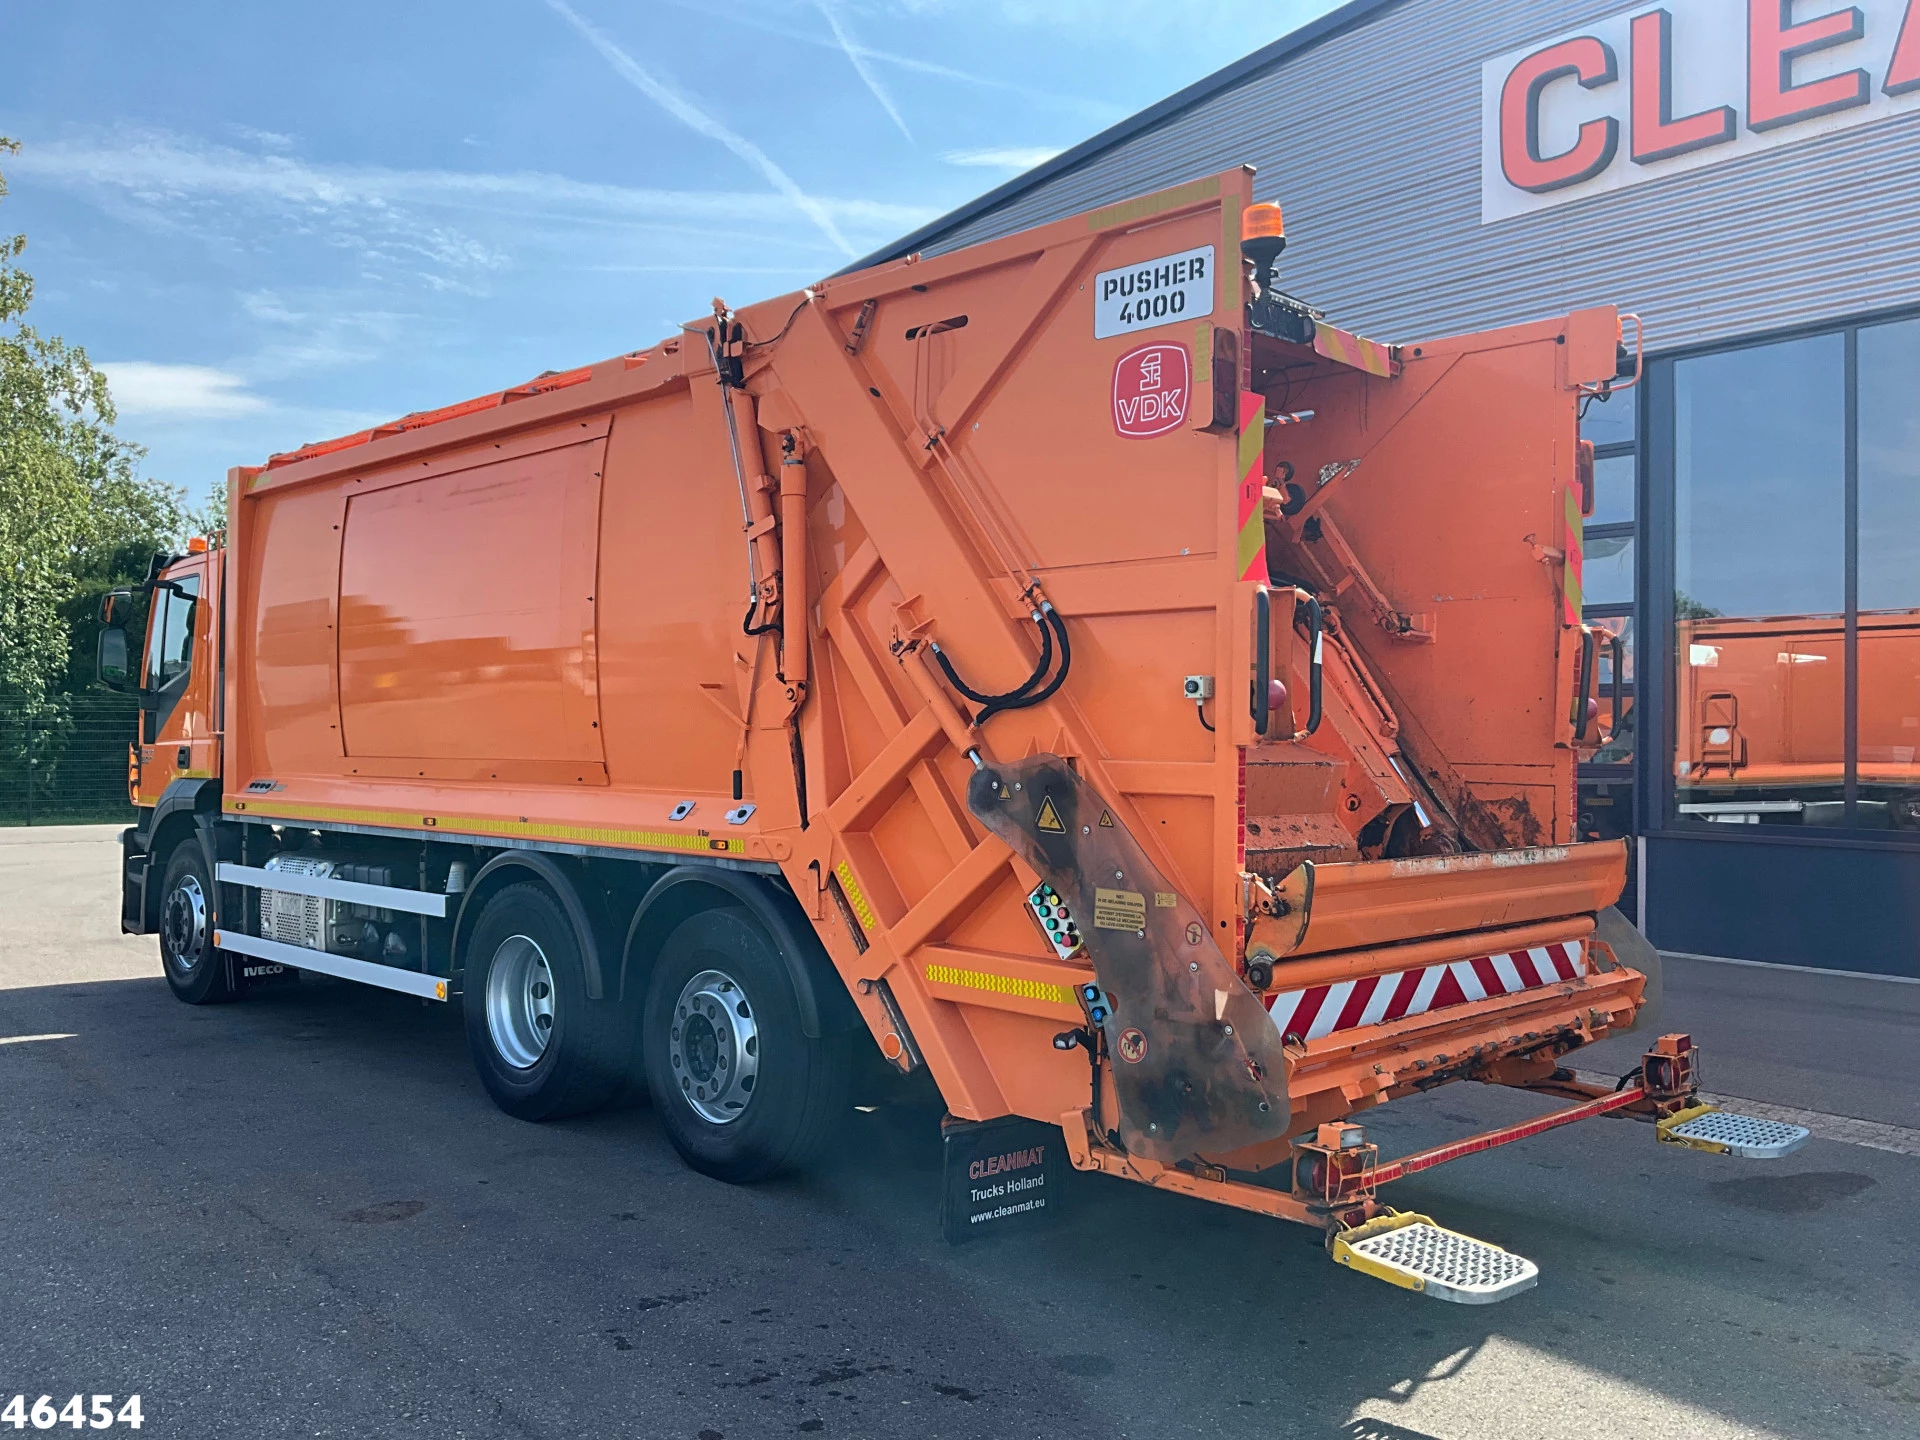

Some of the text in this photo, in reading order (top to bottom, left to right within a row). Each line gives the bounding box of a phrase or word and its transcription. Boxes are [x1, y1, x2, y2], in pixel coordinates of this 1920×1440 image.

[1103, 257, 1205, 301] PUSHER
[1119, 290, 1185, 323] 4000
[1118, 388, 1180, 425] VDK
[243, 965, 284, 977] IVECO
[969, 1146, 1045, 1180] CLEANMAT
[970, 1174, 1044, 1202] Trucks Holland
[970, 1197, 1045, 1224] www.cleanmat.eu
